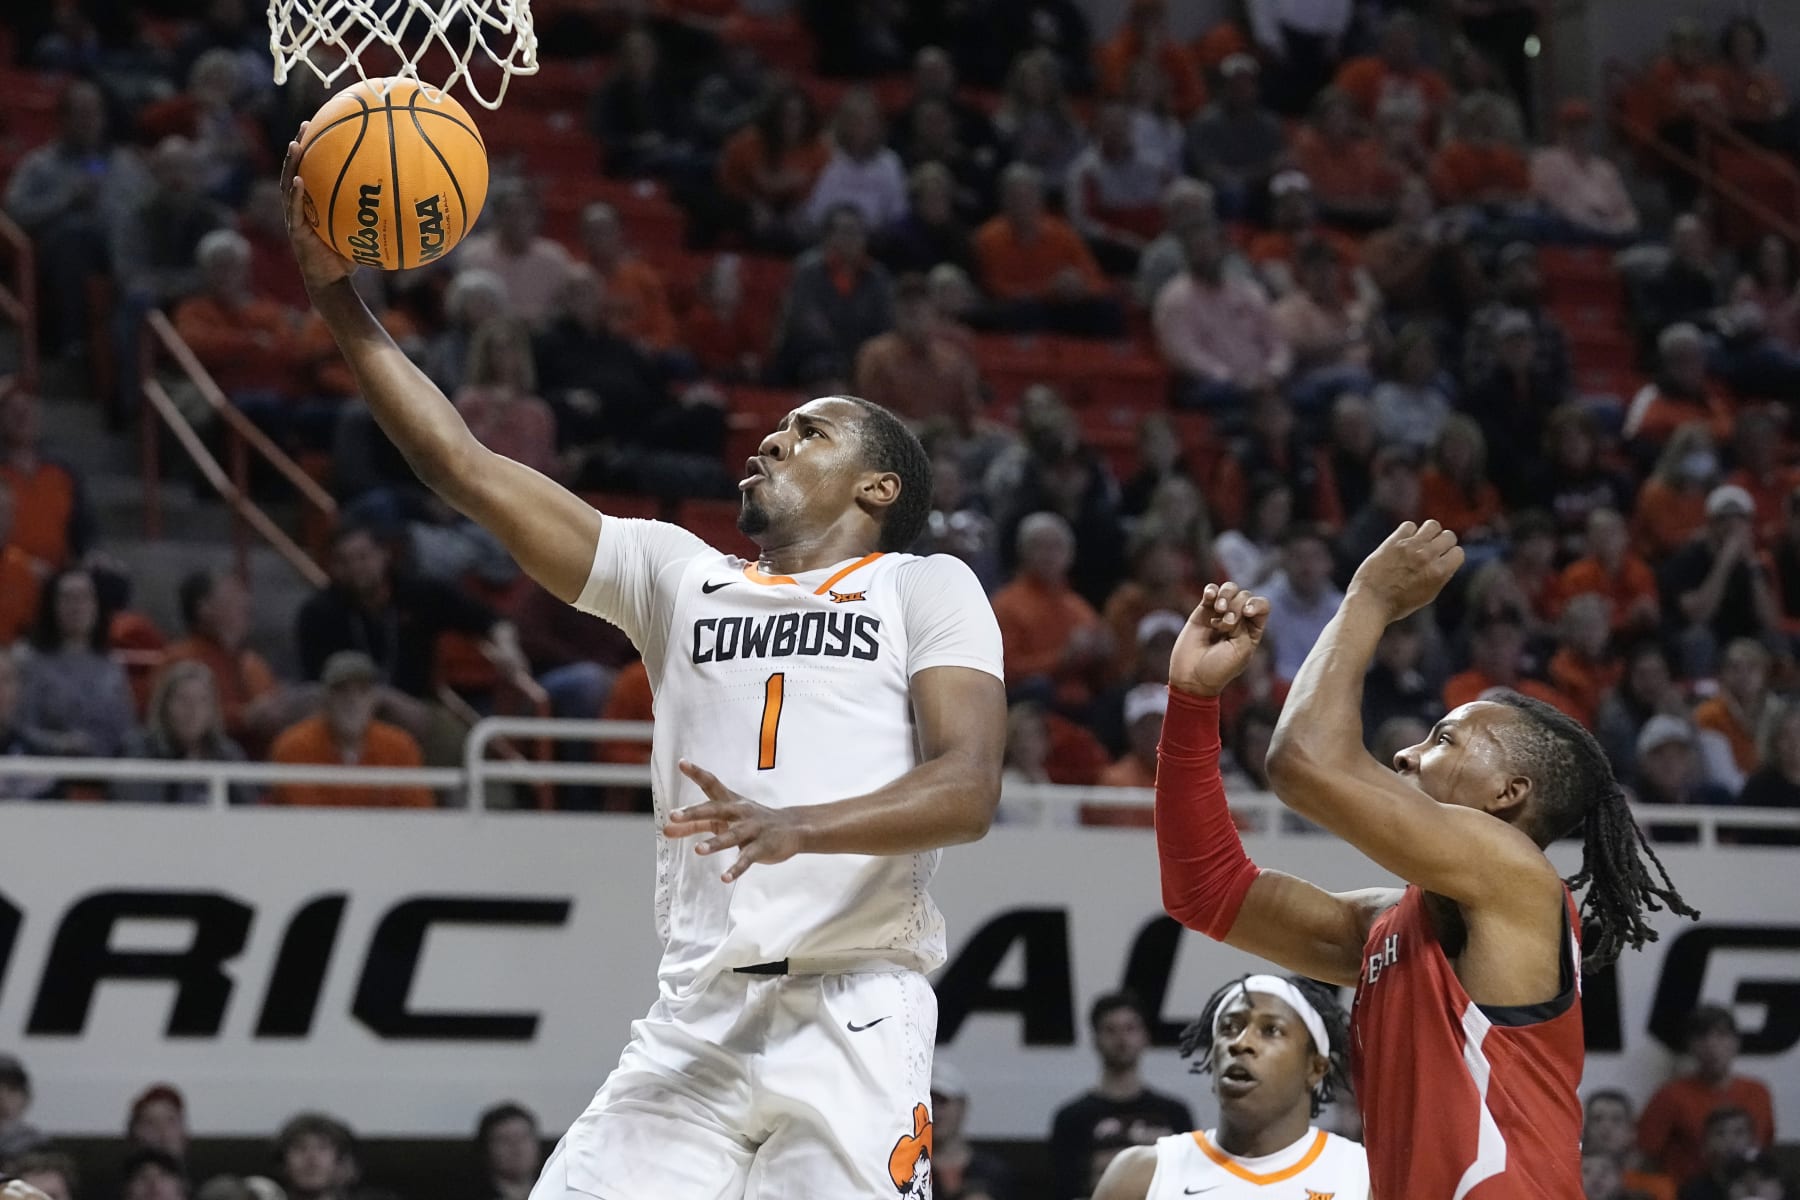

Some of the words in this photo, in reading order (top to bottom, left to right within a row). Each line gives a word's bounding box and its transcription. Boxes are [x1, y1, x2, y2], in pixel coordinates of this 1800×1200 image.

[415, 195, 444, 262] NCAA
[692, 612, 880, 664] COWBOYS
[757, 672, 784, 770] 1
[0, 887, 575, 1040] RIC
